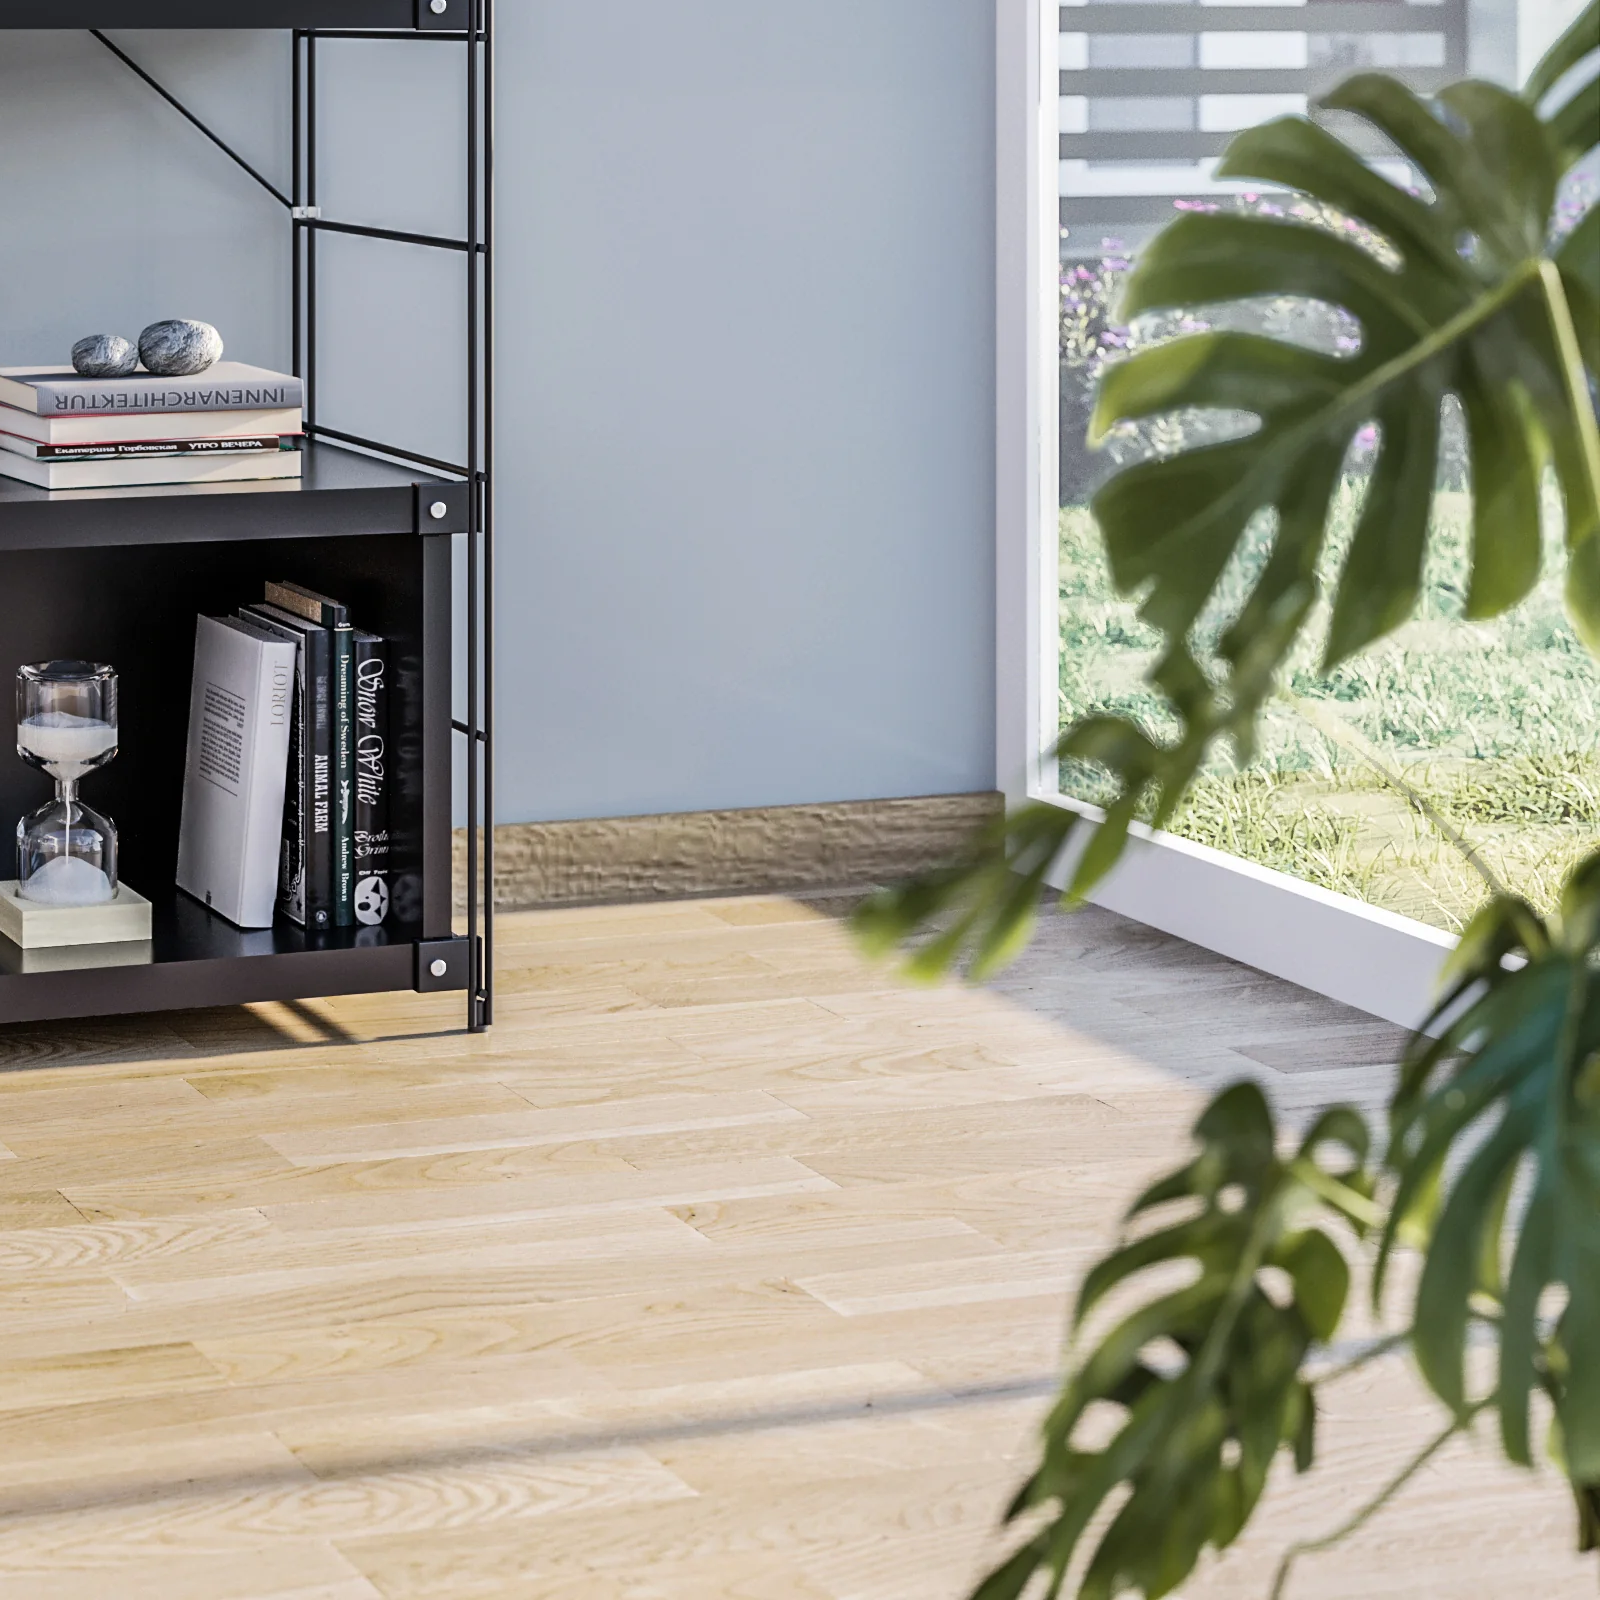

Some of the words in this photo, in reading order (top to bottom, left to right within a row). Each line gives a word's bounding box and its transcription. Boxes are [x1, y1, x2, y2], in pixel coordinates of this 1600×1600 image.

[55, 387, 286, 410] INNENARCHITEKTUR
[54, 445, 116, 455] Екатерина
[118, 443, 178, 453] Горбовская
[188, 441, 218, 450] УТРО
[221, 440, 263, 449] ВЕЧЕРА
[271, 662, 288, 726] LORIOT
[338, 654, 350, 709] Dreaming
[357, 658, 385, 729] Snow
[340, 711, 350, 723] of
[340, 725, 349, 769] Sweden
[315, 754, 328, 799] ANIMAL
[357, 734, 385, 806] White
[315, 801, 328, 833] FARM
[341, 835, 350, 870] Andrew
[341, 873, 350, 902] Brown
